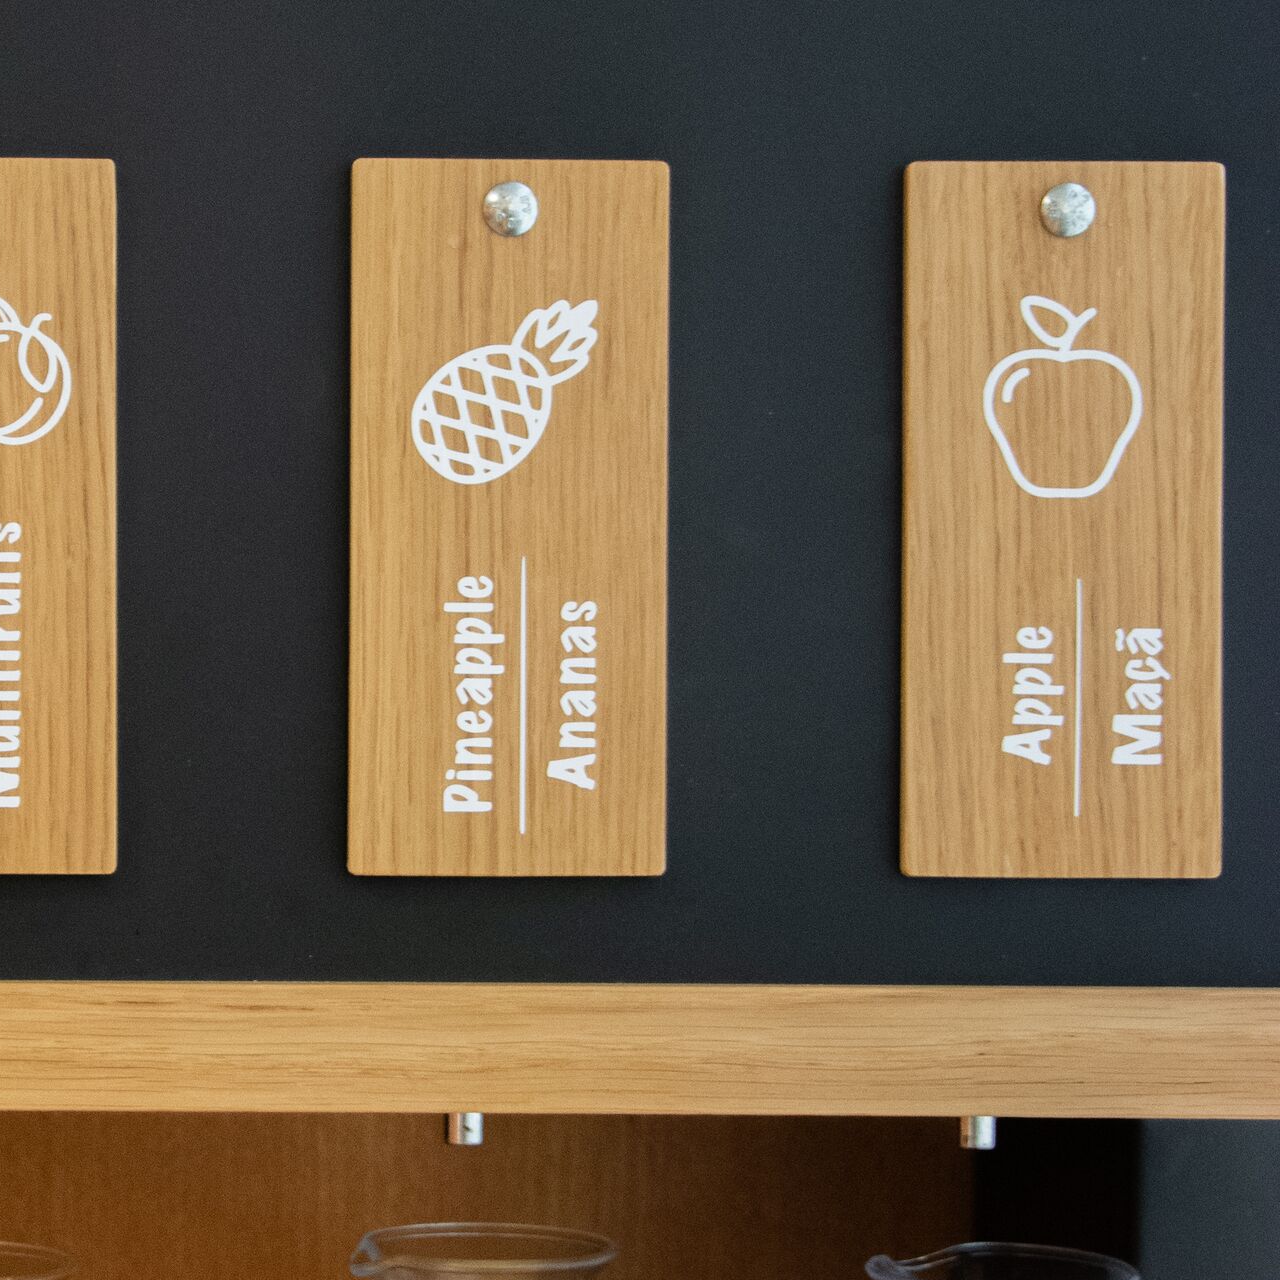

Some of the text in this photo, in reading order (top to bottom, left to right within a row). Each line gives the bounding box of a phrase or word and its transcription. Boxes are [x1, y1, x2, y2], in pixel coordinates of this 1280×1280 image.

[442, 575, 506, 814] Pineapple
[546, 600, 599, 791] Ananas
[1001, 625, 1067, 766] Apple
[1110, 626, 1173, 767] Maçã
